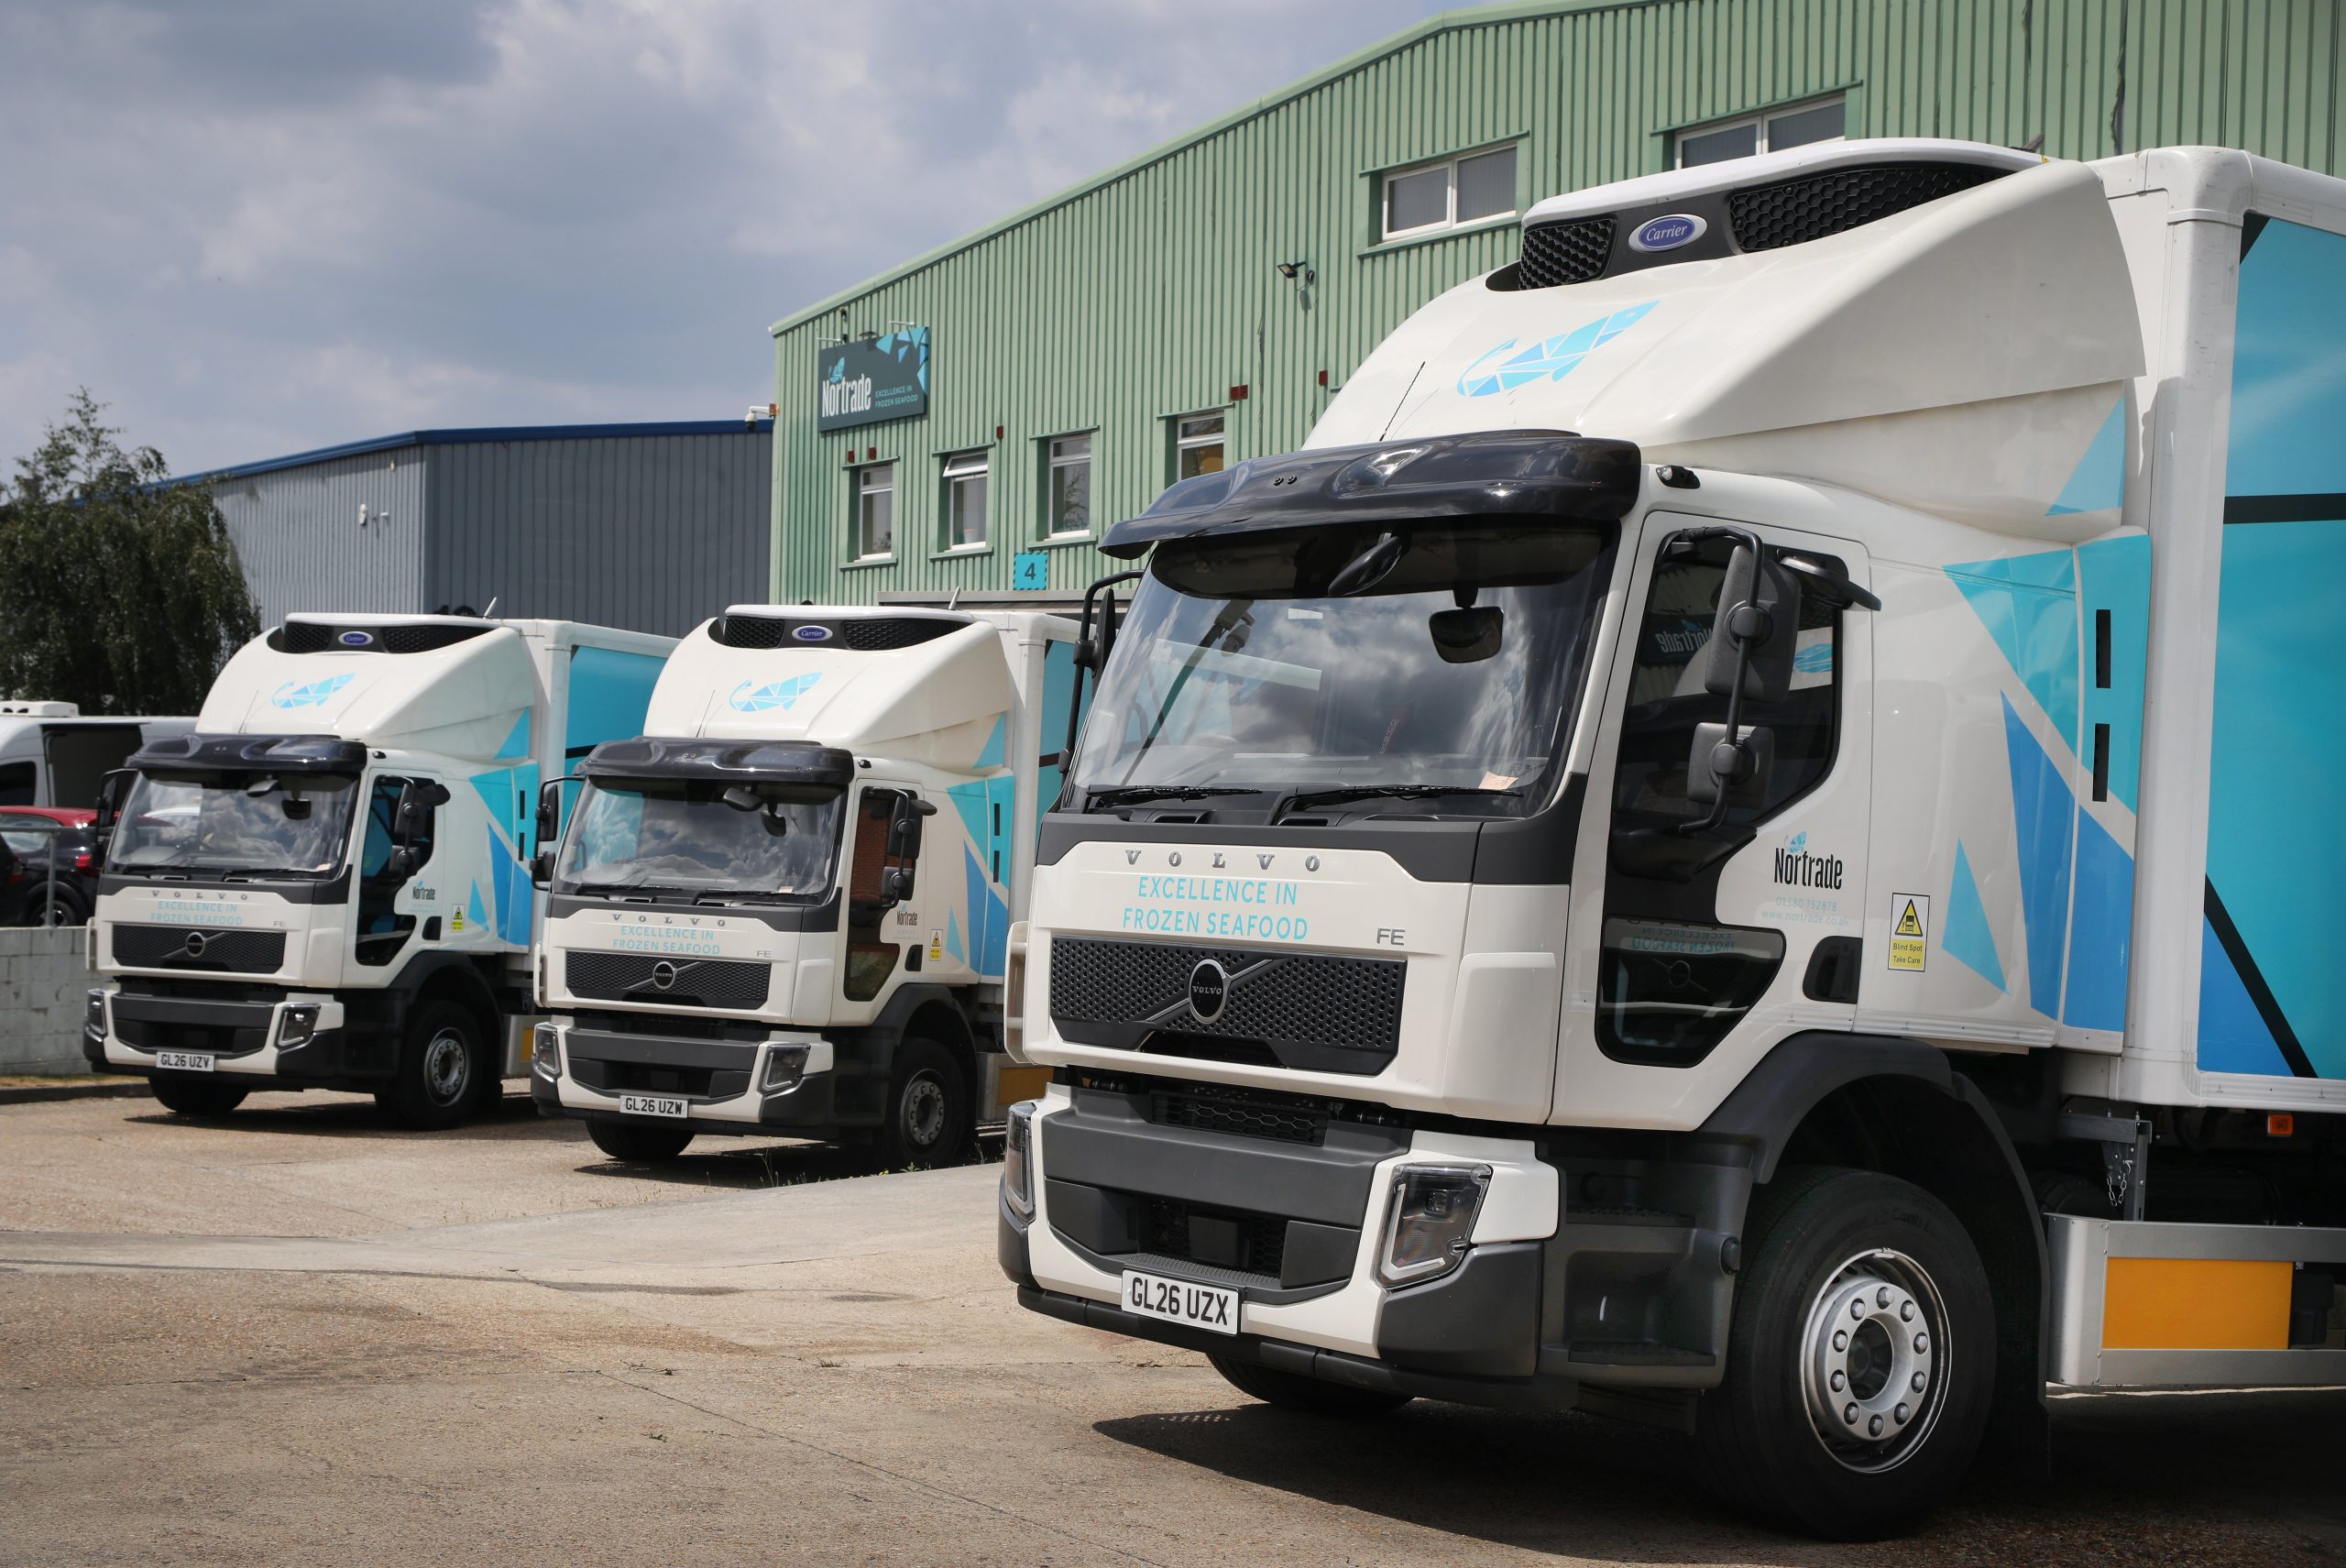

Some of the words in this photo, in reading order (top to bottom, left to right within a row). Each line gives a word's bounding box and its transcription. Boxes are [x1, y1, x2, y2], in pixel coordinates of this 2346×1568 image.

[1646, 224, 1688, 242] Carrier
[822, 373, 872, 418] Nortrade
[875, 386, 905, 398] EXCELLENCE
[875, 398, 894, 409] FROZEN
[894, 394, 918, 405] SEAFOOD
[1024, 562, 1036, 581] 4
[1124, 849, 1321, 872] VOLVO
[1774, 847, 1843, 890] Nortrade
[151, 890, 248, 901] VOLVO
[1138, 876, 1267, 904] EXCELLENCE
[1276, 883, 1298, 905] IN
[158, 901, 223, 912] EXCELLENCE
[226, 904, 237, 913] IN
[150, 912, 191, 923] FROZEN
[193, 916, 244, 926] SEAFOOD
[612, 914, 726, 927] VOLVO
[1123, 907, 1200, 933] FROZEN
[1206, 912, 1308, 940] SEAFOOD
[620, 926, 696, 939] EXCELLENCE
[701, 929, 714, 940] IN
[1376, 927, 1406, 946] FE
[612, 938, 659, 951] FROZEN
[663, 941, 721, 955] SEAFOOD
[756, 949, 771, 958] FE
[1909, 944, 1923, 952] Spot
[1192, 985, 1222, 995] VOLVO
[160, 1053, 187, 1067] GL26
[189, 1056, 210, 1069] UZV
[625, 1097, 655, 1113] GL26
[658, 1100, 683, 1115] UZW
[1132, 1277, 1180, 1316] GL26
[1187, 1288, 1229, 1326] UZX
